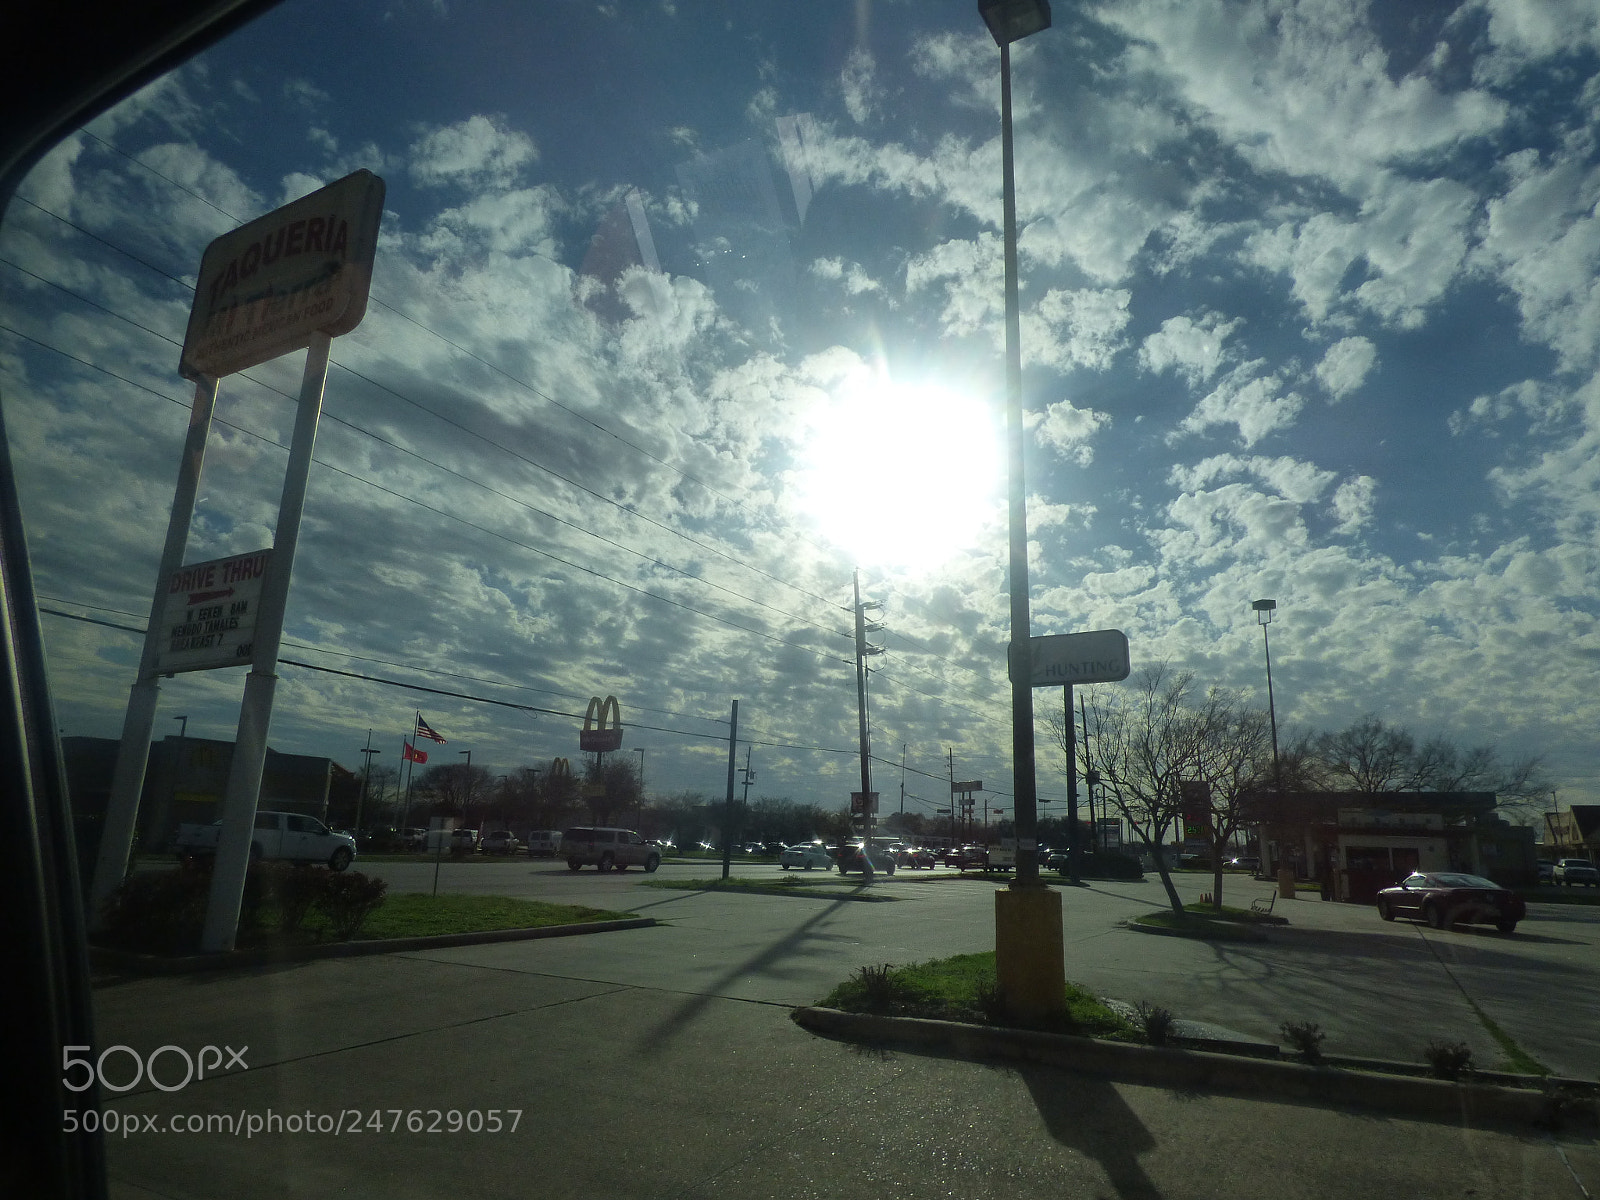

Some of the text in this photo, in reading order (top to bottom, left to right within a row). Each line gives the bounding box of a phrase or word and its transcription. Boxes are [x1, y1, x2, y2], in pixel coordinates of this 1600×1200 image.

[168, 555, 265, 594] DRIVE THRU
[1046, 659, 1121, 677] HUNTING
